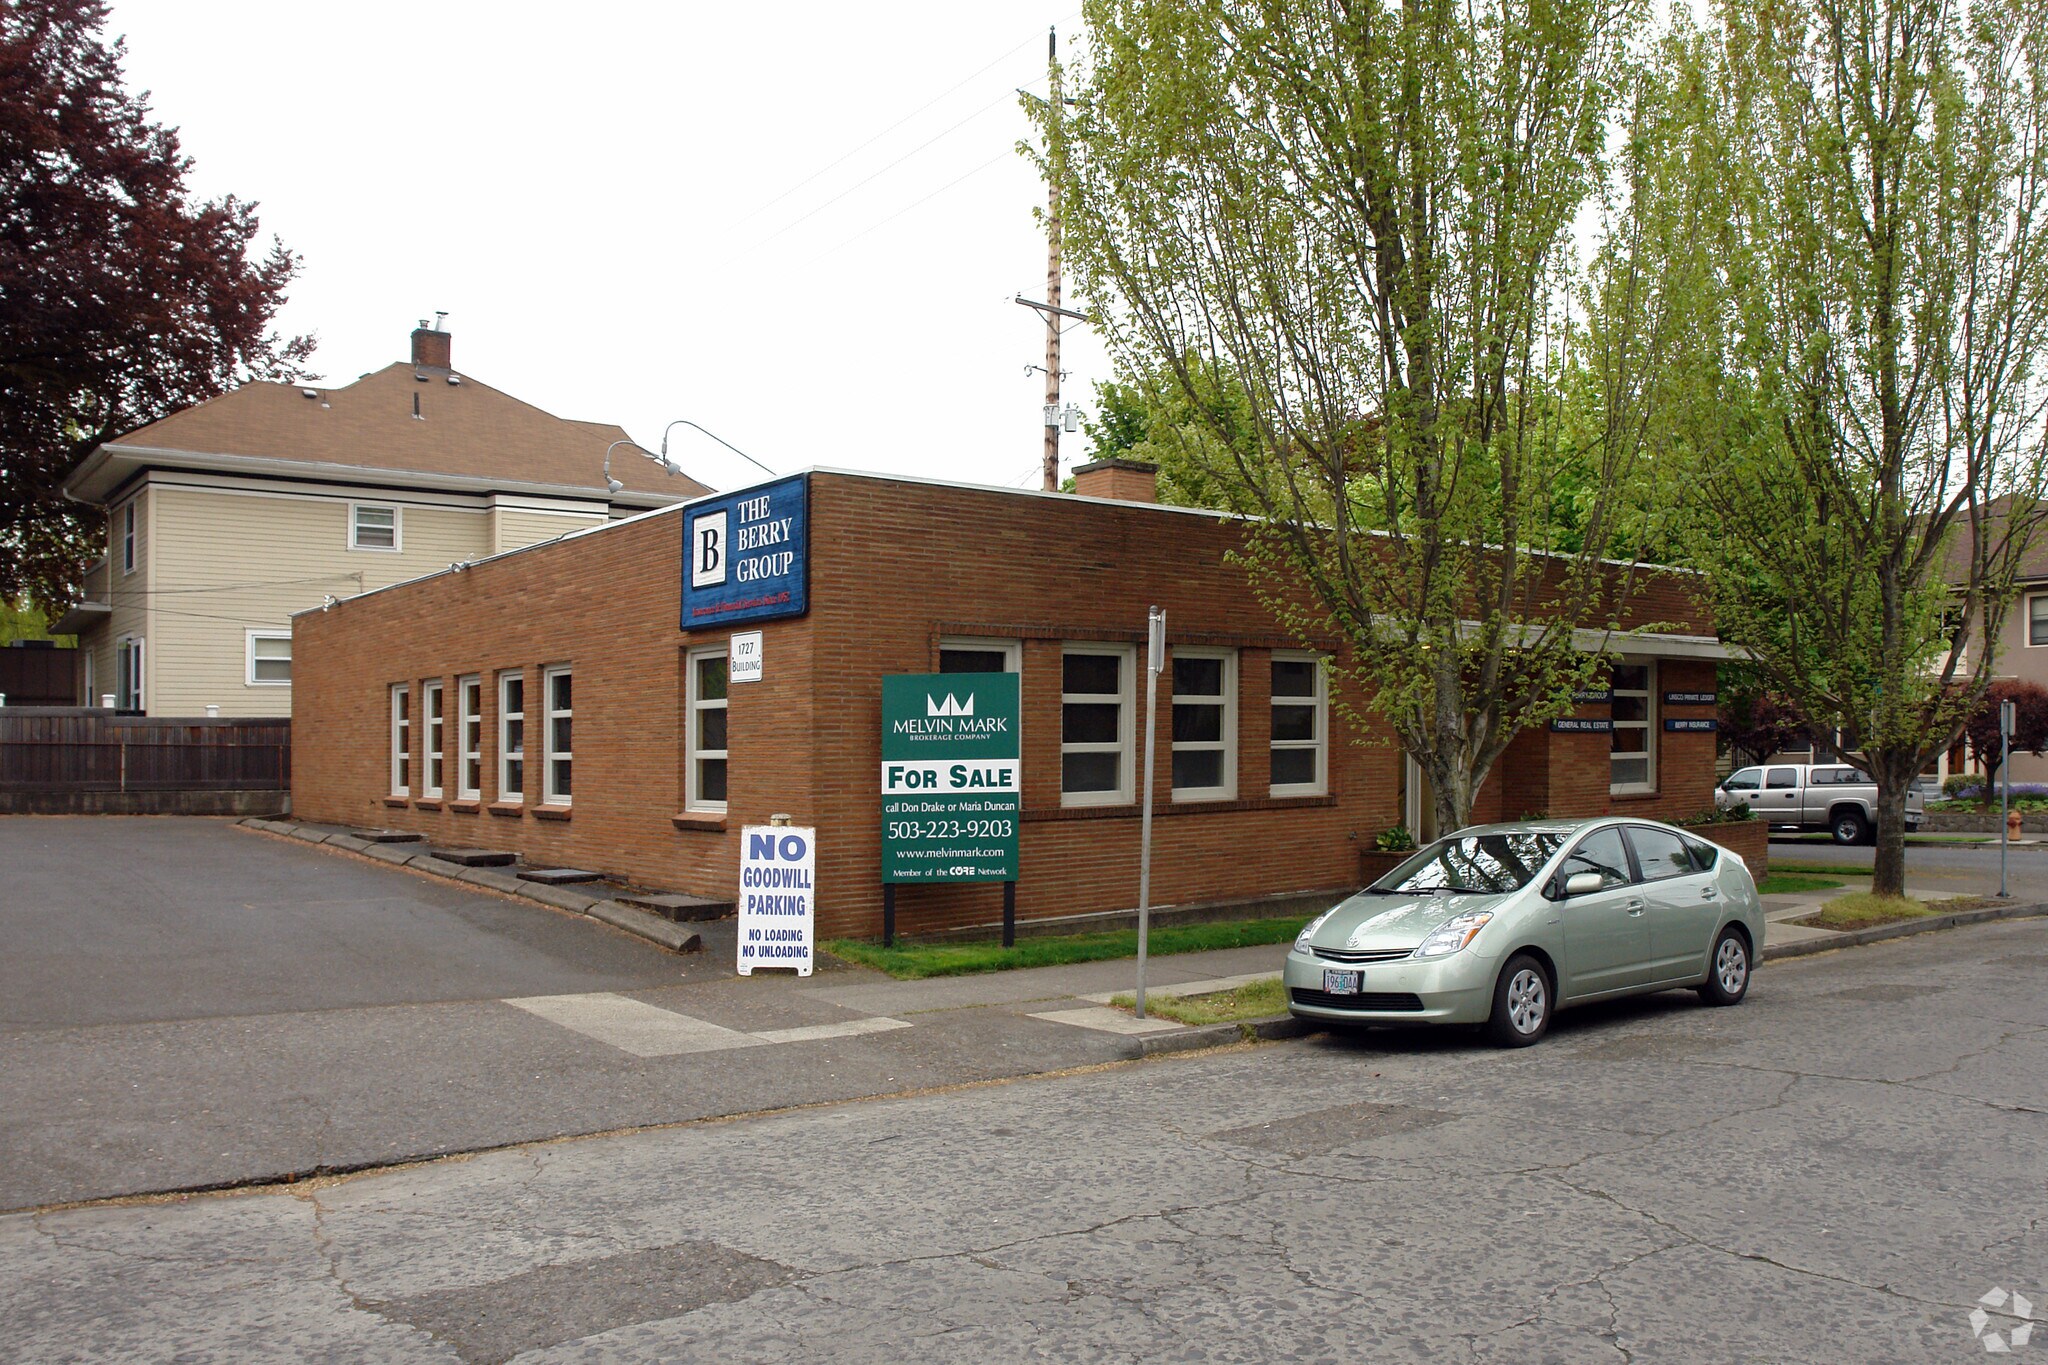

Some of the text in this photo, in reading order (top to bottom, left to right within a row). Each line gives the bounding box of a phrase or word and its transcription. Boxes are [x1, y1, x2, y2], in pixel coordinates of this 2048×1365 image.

[738, 496, 770, 523] THE
[738, 518, 792, 551] BERRY
[700, 529, 719, 573] B
[737, 552, 794, 582] GROUP
[738, 642, 753, 655] 1727
[732, 660, 760, 672] BUILDING
[893, 717, 1007, 734] MELVIN MARK
[888, 765, 1012, 789] FOR SALE
[886, 802, 1014, 812] call Don Drake or Maria Duncan
[888, 820, 1011, 839] 503-223-9203
[750, 834, 806, 861] NO
[897, 848, 1004, 858] www.melvinmark.com
[744, 867, 811, 888] GOODWILL
[893, 869, 921, 877] Member
[937, 868, 947, 876] the
[950, 867, 975, 876] CORE
[748, 895, 805, 916] PARKING
[749, 929, 802, 941] NO LOADING
[742, 946, 808, 958] NO UNLOADING
